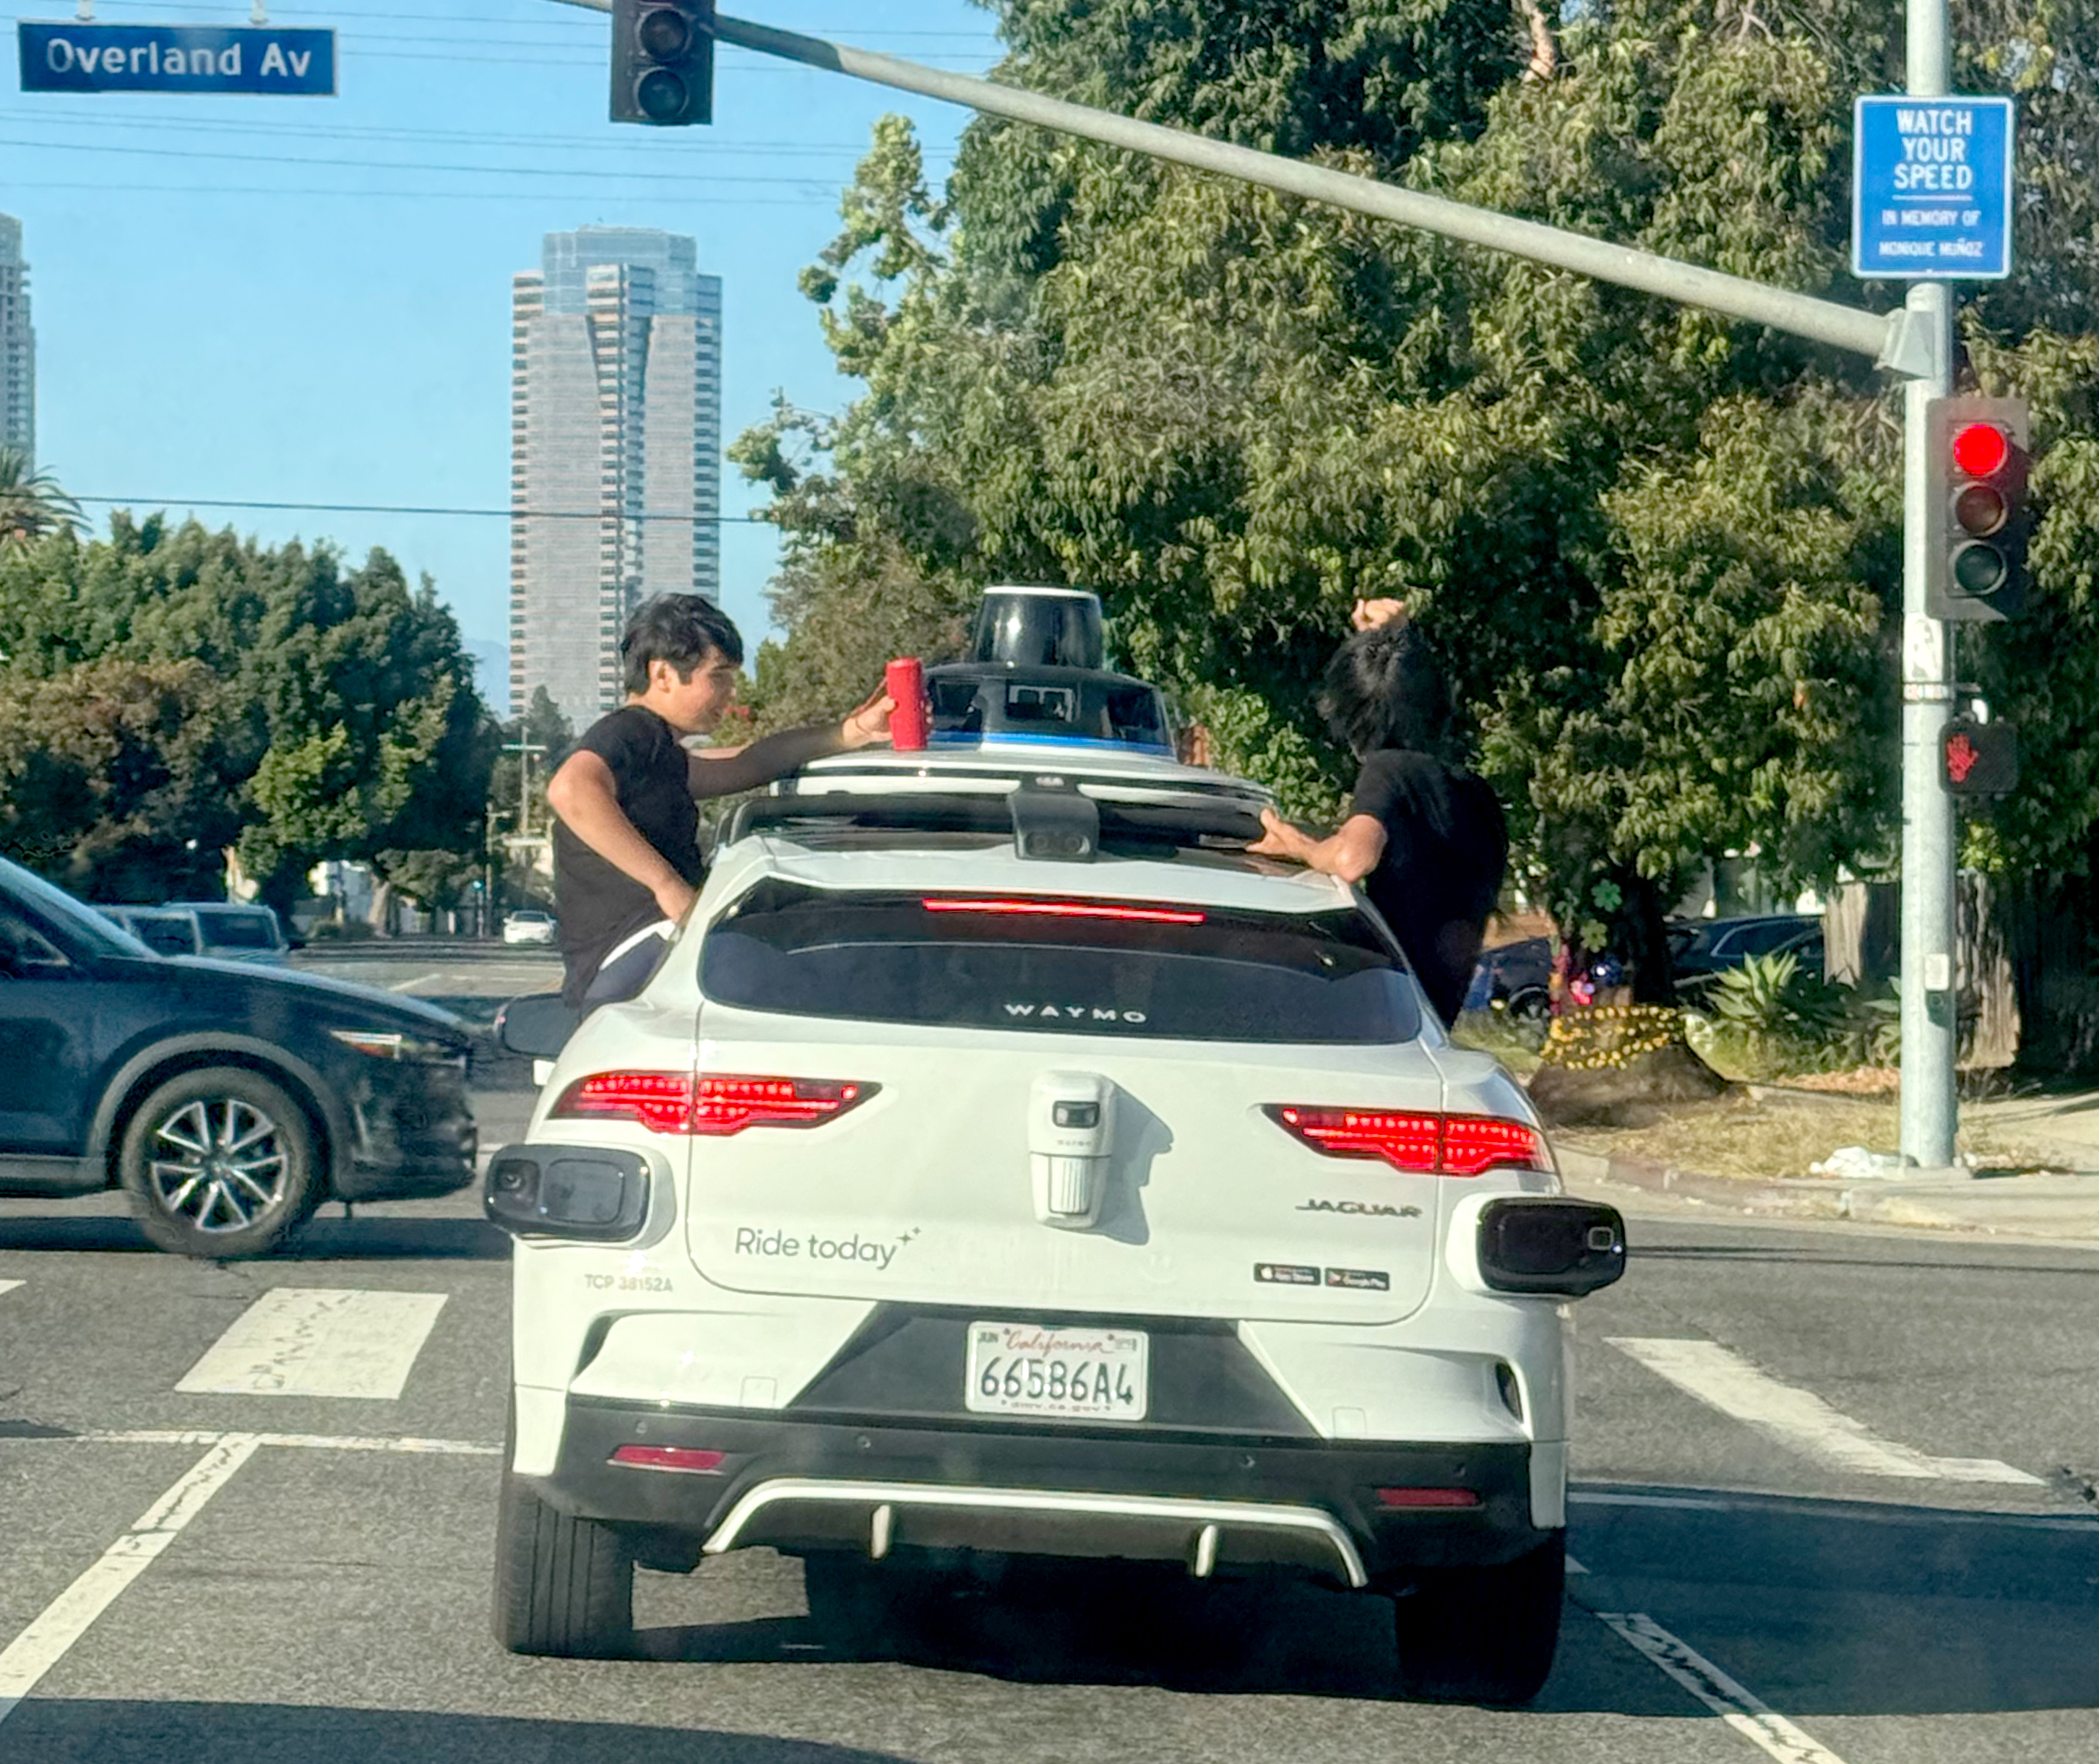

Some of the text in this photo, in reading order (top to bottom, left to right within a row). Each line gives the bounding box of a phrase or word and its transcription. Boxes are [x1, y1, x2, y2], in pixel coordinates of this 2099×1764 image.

[46, 38, 311, 77] Overland Av
[1896, 109, 1973, 135] WATCH
[1902, 137, 1966, 163] YOUR
[1893, 163, 1973, 190] SPEED
[1882, 209, 1982, 227] IN MEMORY OF
[1879, 241, 1936, 257] MONIQUE
[1004, 1003, 1147, 1024] WAYMO
[1295, 1198, 1423, 1218] JAGUAR
[735, 1227, 897, 1271] Ride today
[584, 1274, 615, 1289] TCP
[1006, 1329, 1116, 1358] California
[980, 1356, 1134, 1405] 66586A4
